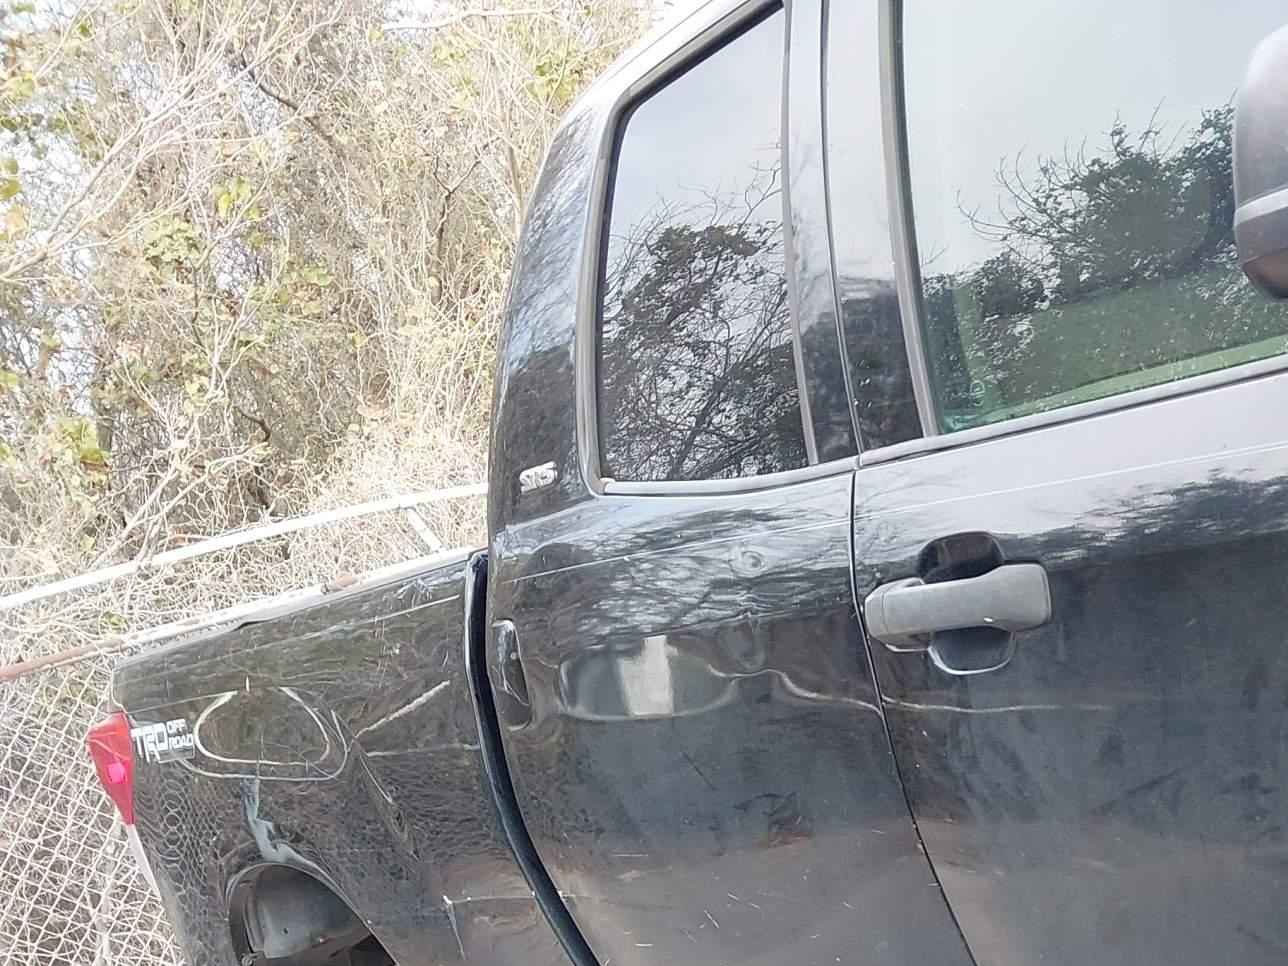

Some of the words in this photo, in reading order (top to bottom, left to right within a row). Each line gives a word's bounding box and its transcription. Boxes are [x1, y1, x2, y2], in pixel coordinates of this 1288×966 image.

[166, 719, 188, 734] OFF
[131, 722, 169, 764] TRD
[168, 733, 194, 750] ROAD
